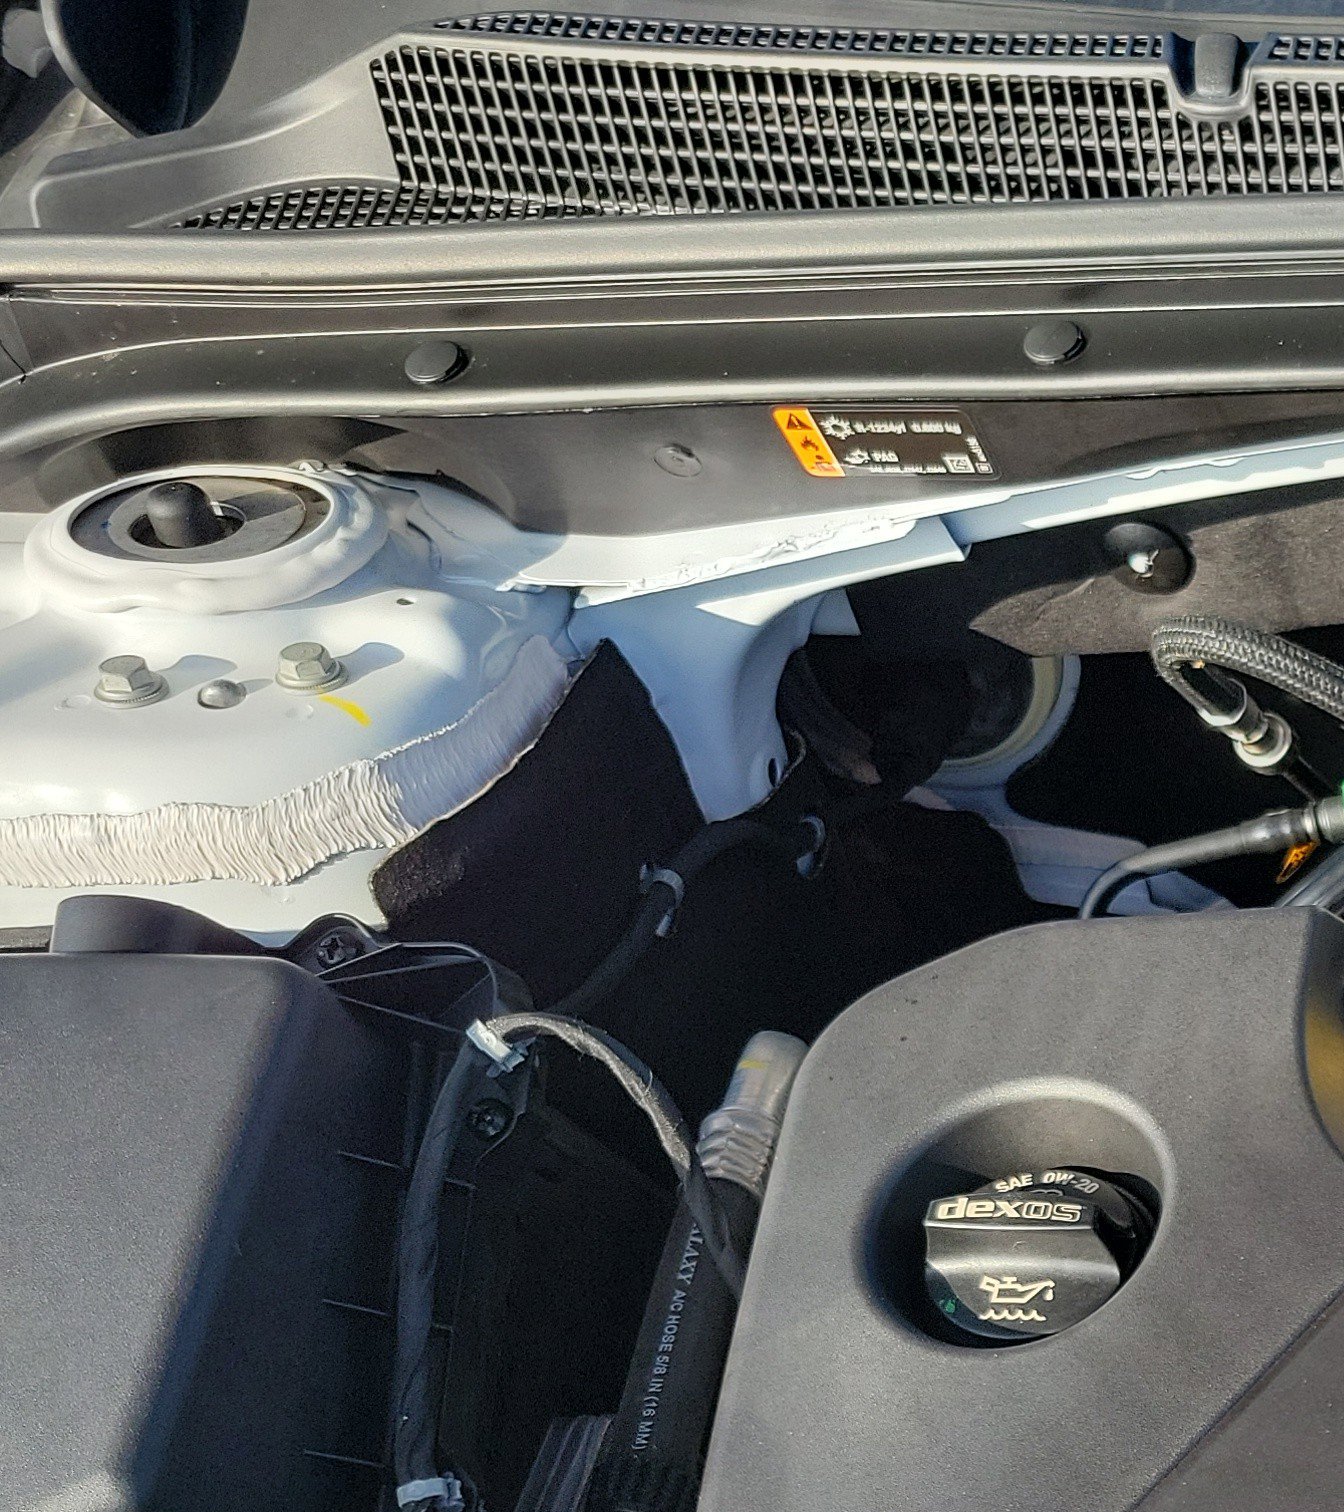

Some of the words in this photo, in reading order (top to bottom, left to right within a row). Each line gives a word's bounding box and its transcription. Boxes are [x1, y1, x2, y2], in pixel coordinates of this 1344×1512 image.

[996, 1173, 1033, 1193] SAE
[937, 1197, 1082, 1223] dexos
[677, 1223, 703, 1285] ALAXY
[671, 1289, 687, 1312] A/C
[658, 1315, 681, 1352] HOSE
[653, 1355, 669, 1375] 5/8
[649, 1378, 664, 1393] IN
